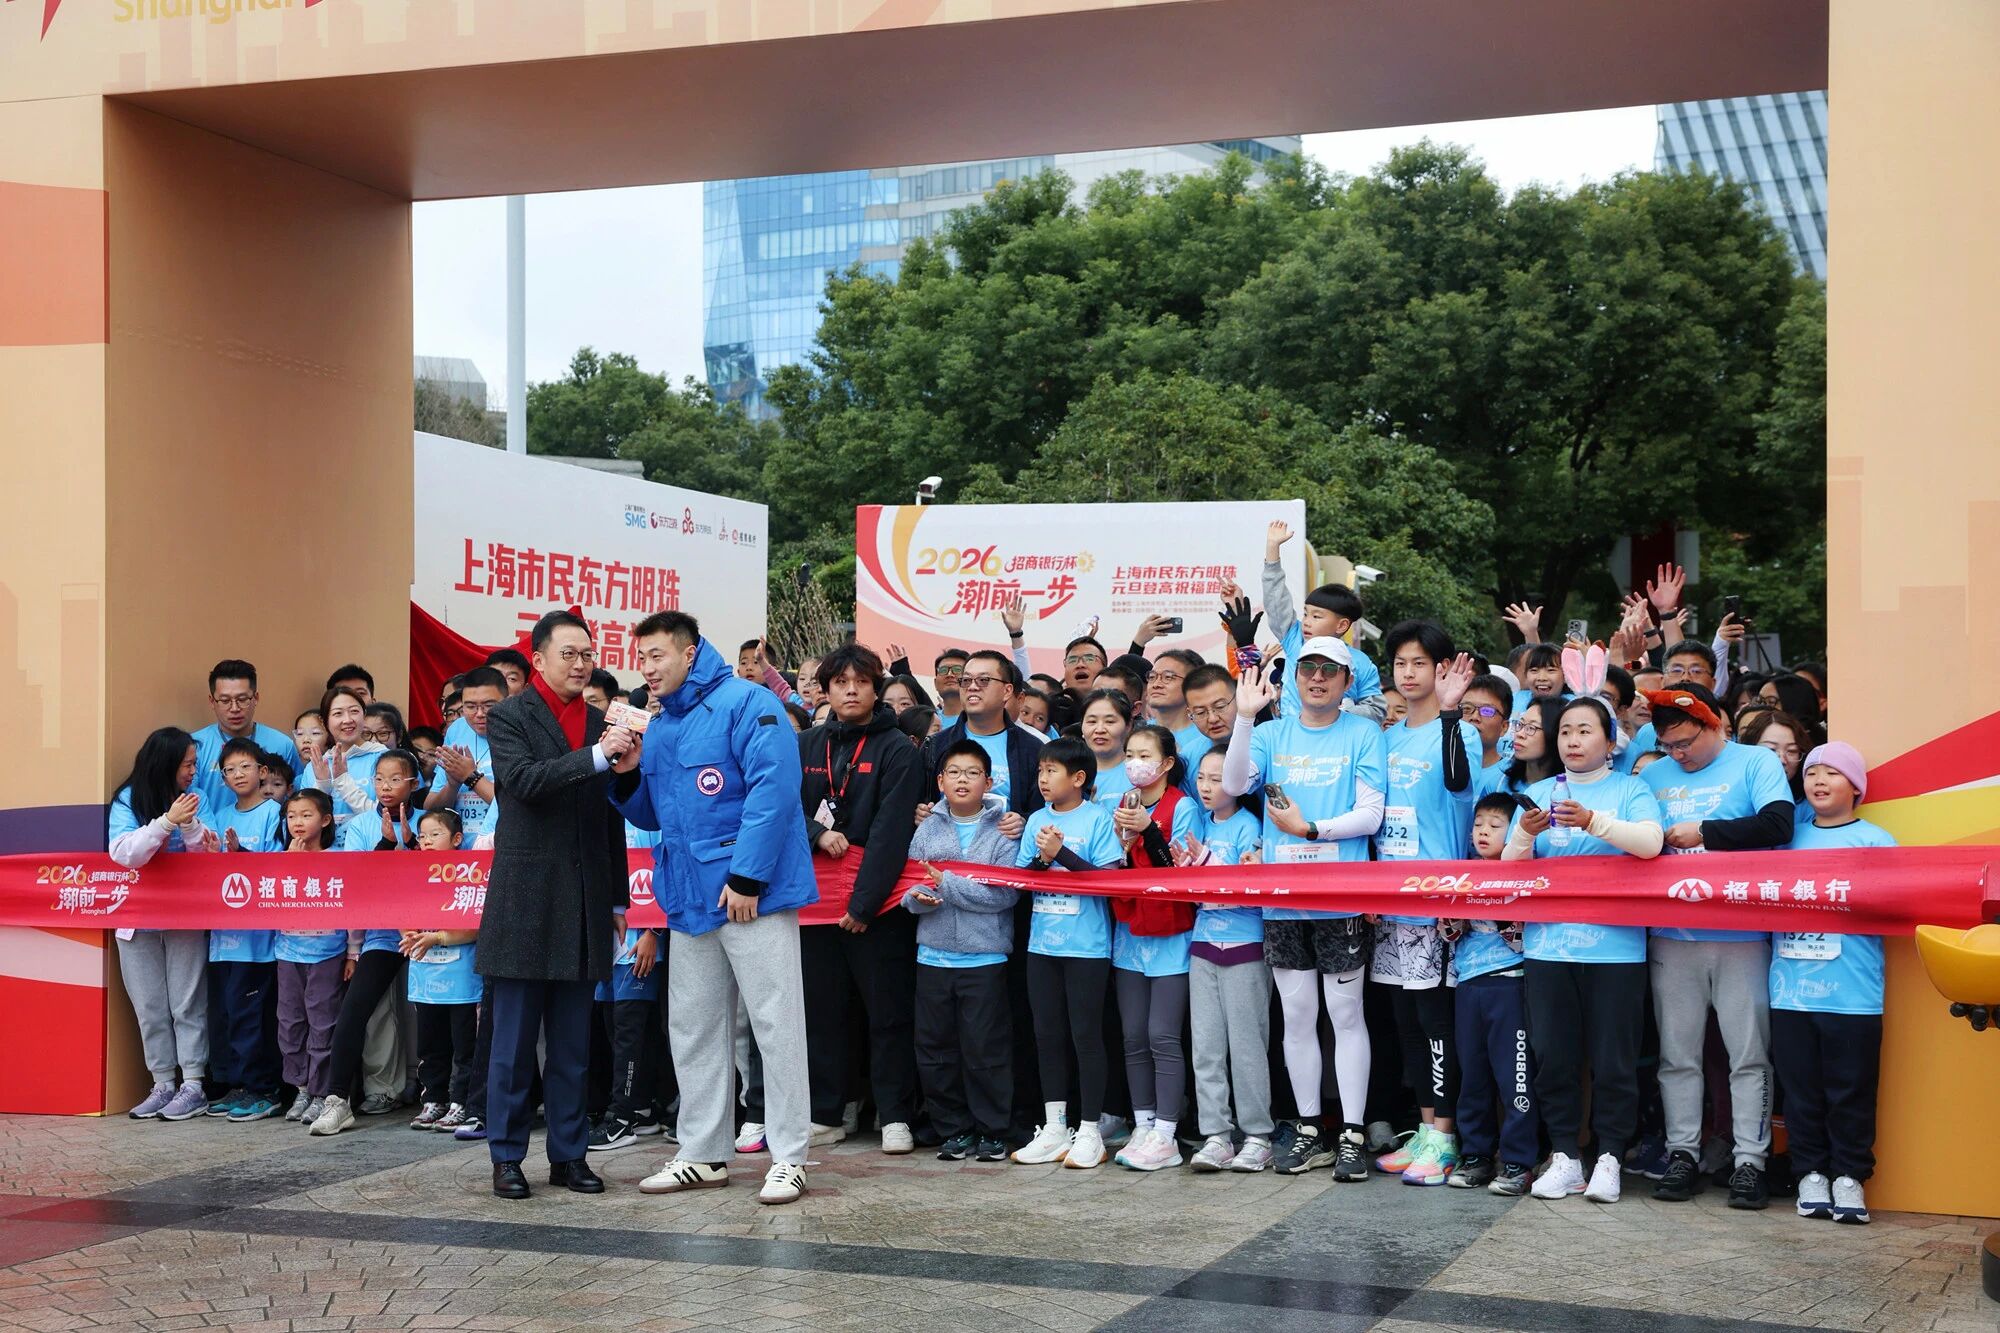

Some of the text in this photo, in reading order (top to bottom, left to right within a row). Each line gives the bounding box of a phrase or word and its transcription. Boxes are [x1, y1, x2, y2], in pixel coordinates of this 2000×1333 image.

[624, 512, 647, 529] SMG
[915, 545, 1001, 576] 2026
[1004, 555, 1078, 573] 招商银行杯
[454, 537, 681, 613] 上海市民东方明珠
[1112, 565, 1237, 580] 上海市民东方明珠
[945, 574, 1077, 622] 潮前一步
[1112, 581, 1223, 595] 元旦登高祝福跑
[36, 864, 88, 886] 2026
[428, 861, 485, 884] 2026
[1400, 873, 1474, 892] 2026
[51, 884, 129, 915] 潮前一步
[1465, 896, 1503, 905] Shanghai
[80, 908, 106, 916] Shanghai
[1429, 1038, 1444, 1097] NIKE
